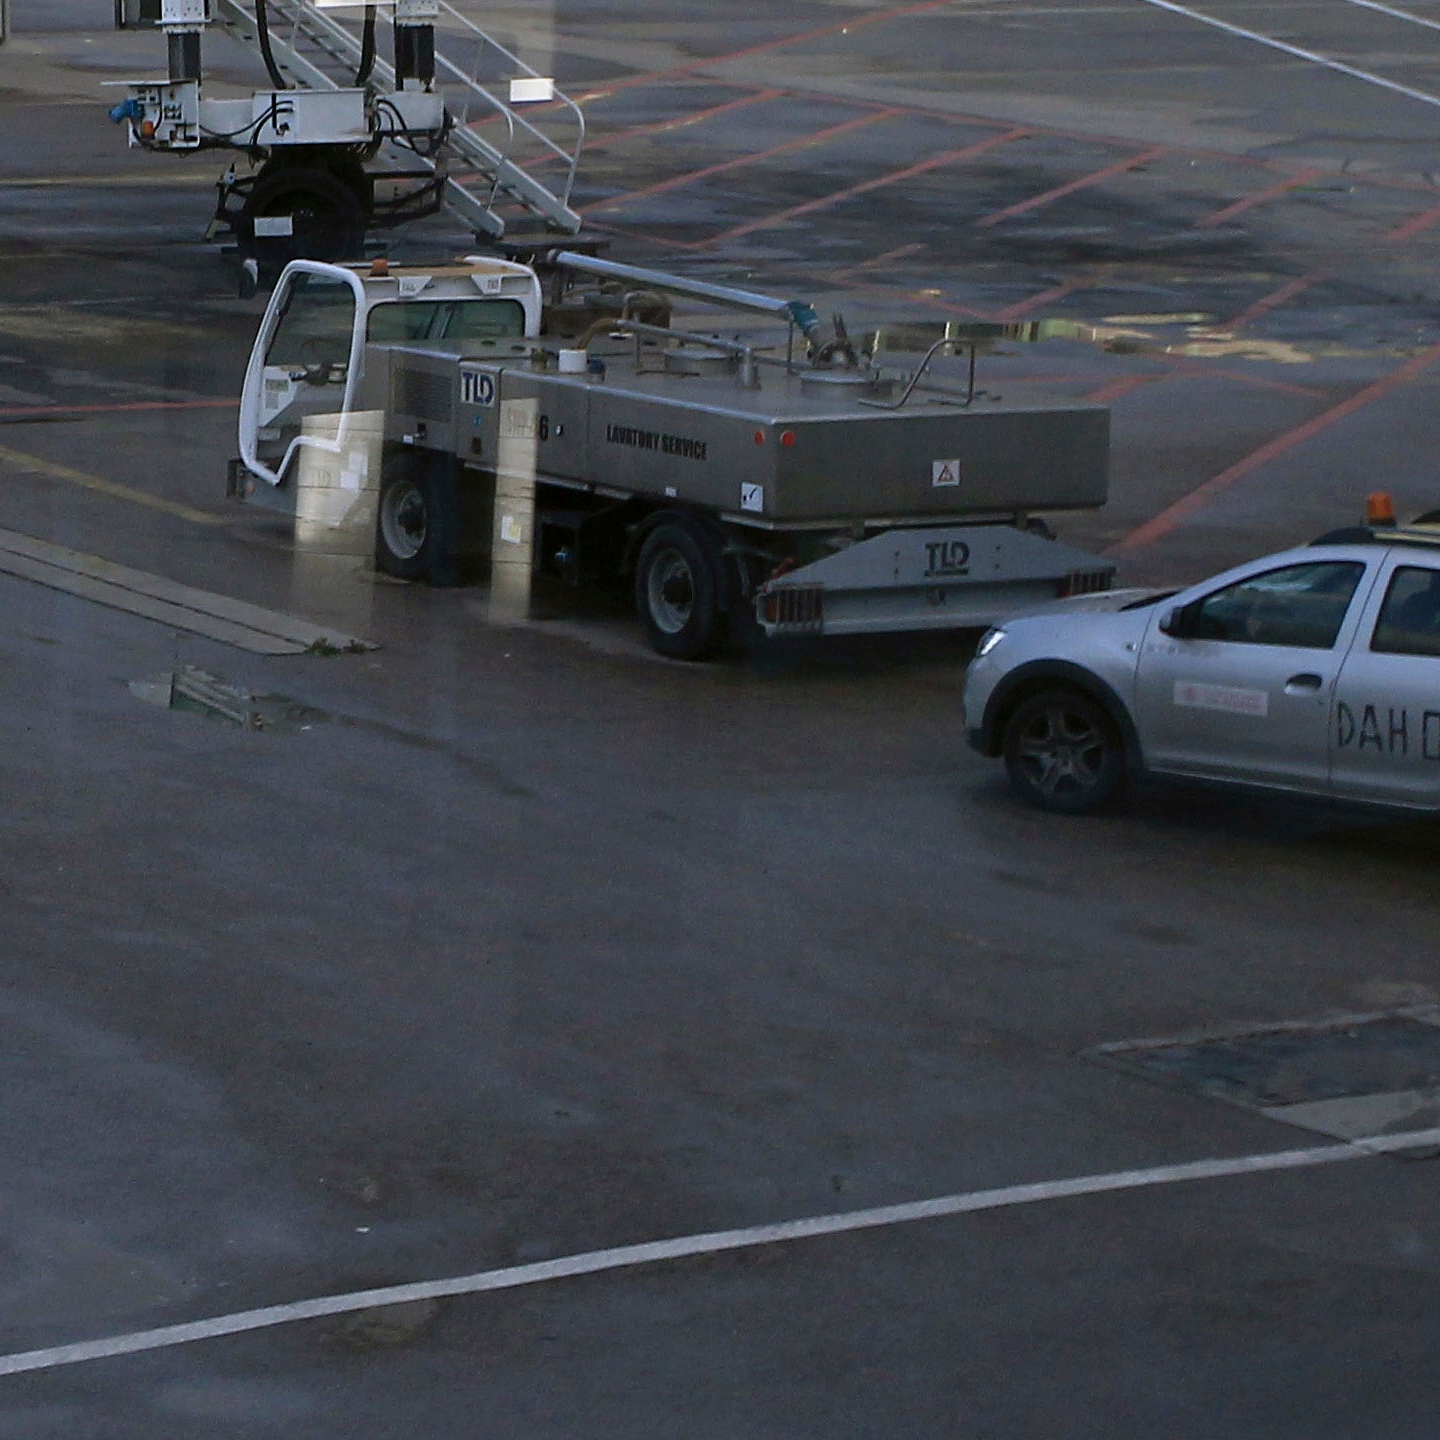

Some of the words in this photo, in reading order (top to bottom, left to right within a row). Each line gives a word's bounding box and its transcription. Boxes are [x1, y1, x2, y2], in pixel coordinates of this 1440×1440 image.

[461, 371, 496, 404] TLD
[606, 423, 660, 451] LAVATORY
[661, 432, 708, 461] SERVICE
[925, 541, 970, 571] TLD
[1337, 700, 1408, 756] DAH
